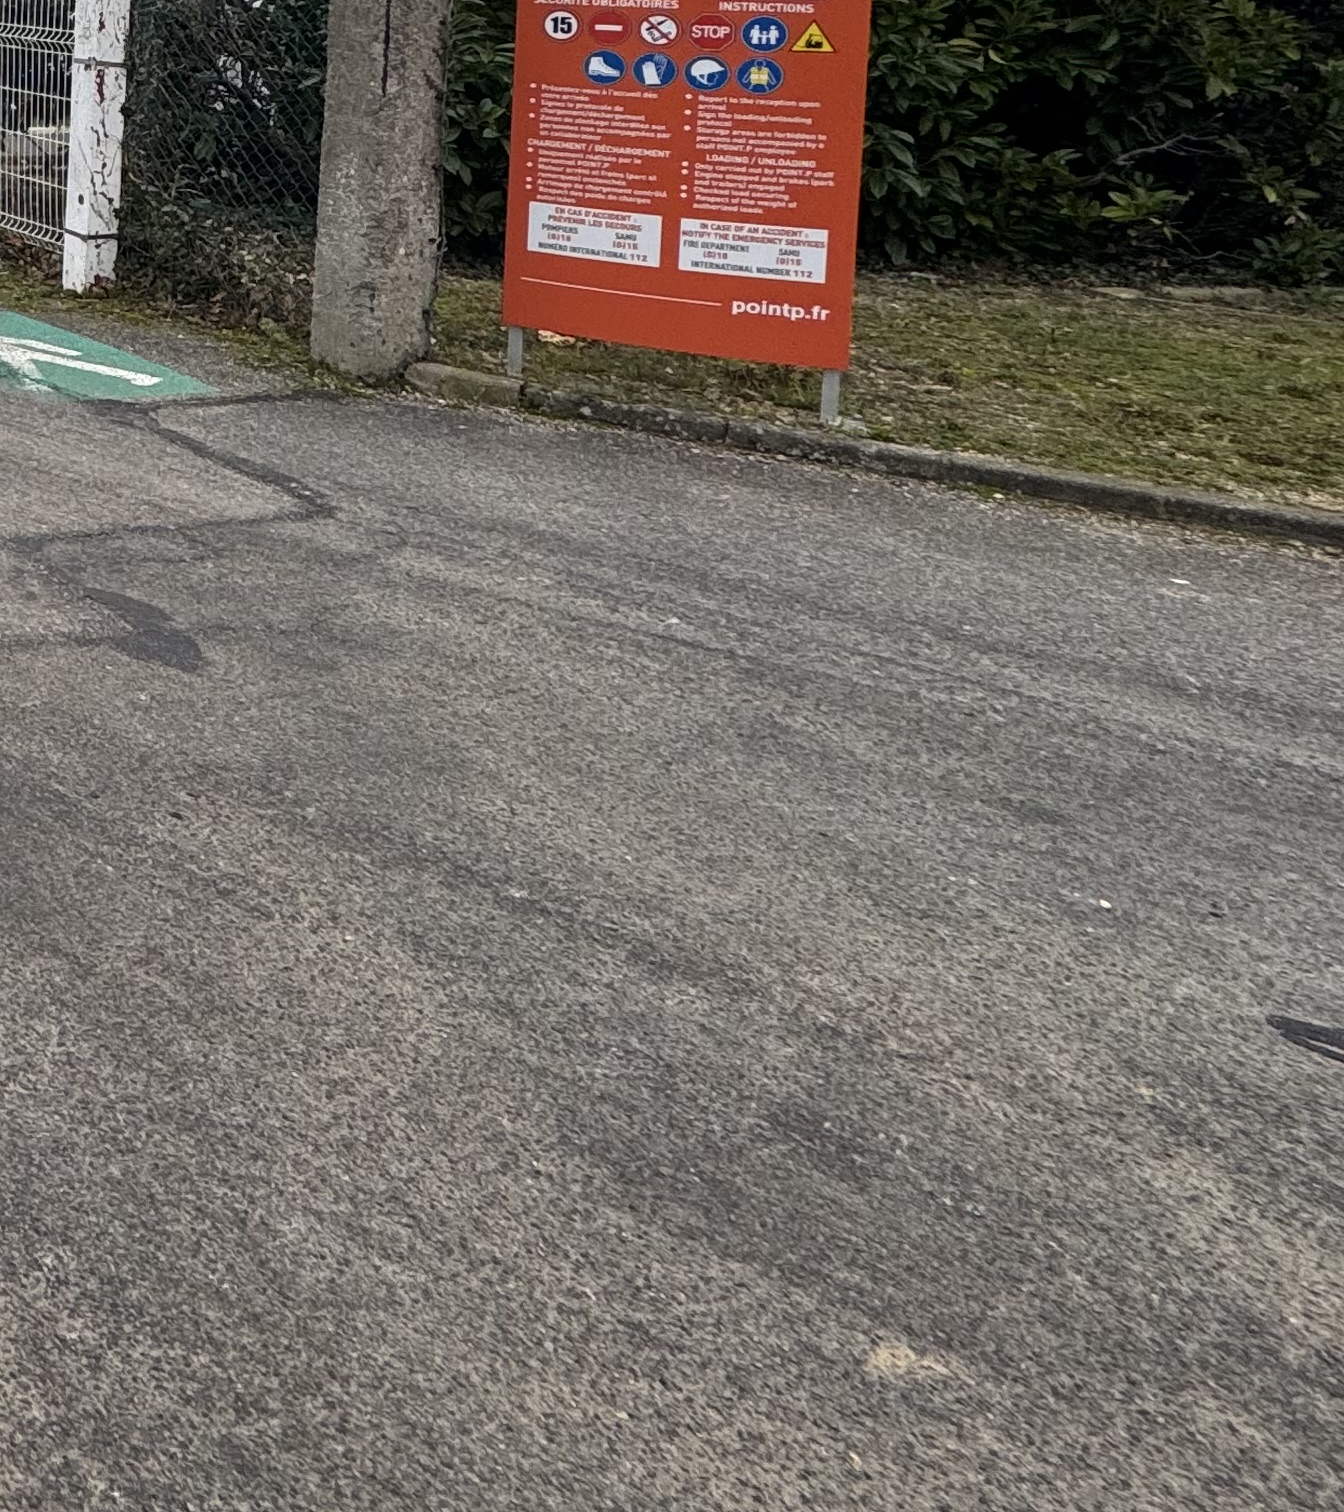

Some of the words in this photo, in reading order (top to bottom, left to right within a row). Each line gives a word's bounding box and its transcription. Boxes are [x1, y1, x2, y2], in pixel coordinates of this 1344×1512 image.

[719, 1, 815, 14] INSTRUCTIONS
[550, 16, 573, 34] 15
[691, 24, 731, 39] STOP
[706, 154, 749, 164] LOADING
[757, 157, 816, 168] UNLOADING
[630, 253, 648, 262] 112
[793, 270, 813, 278] 112
[731, 300, 831, 321] pointp.fr
